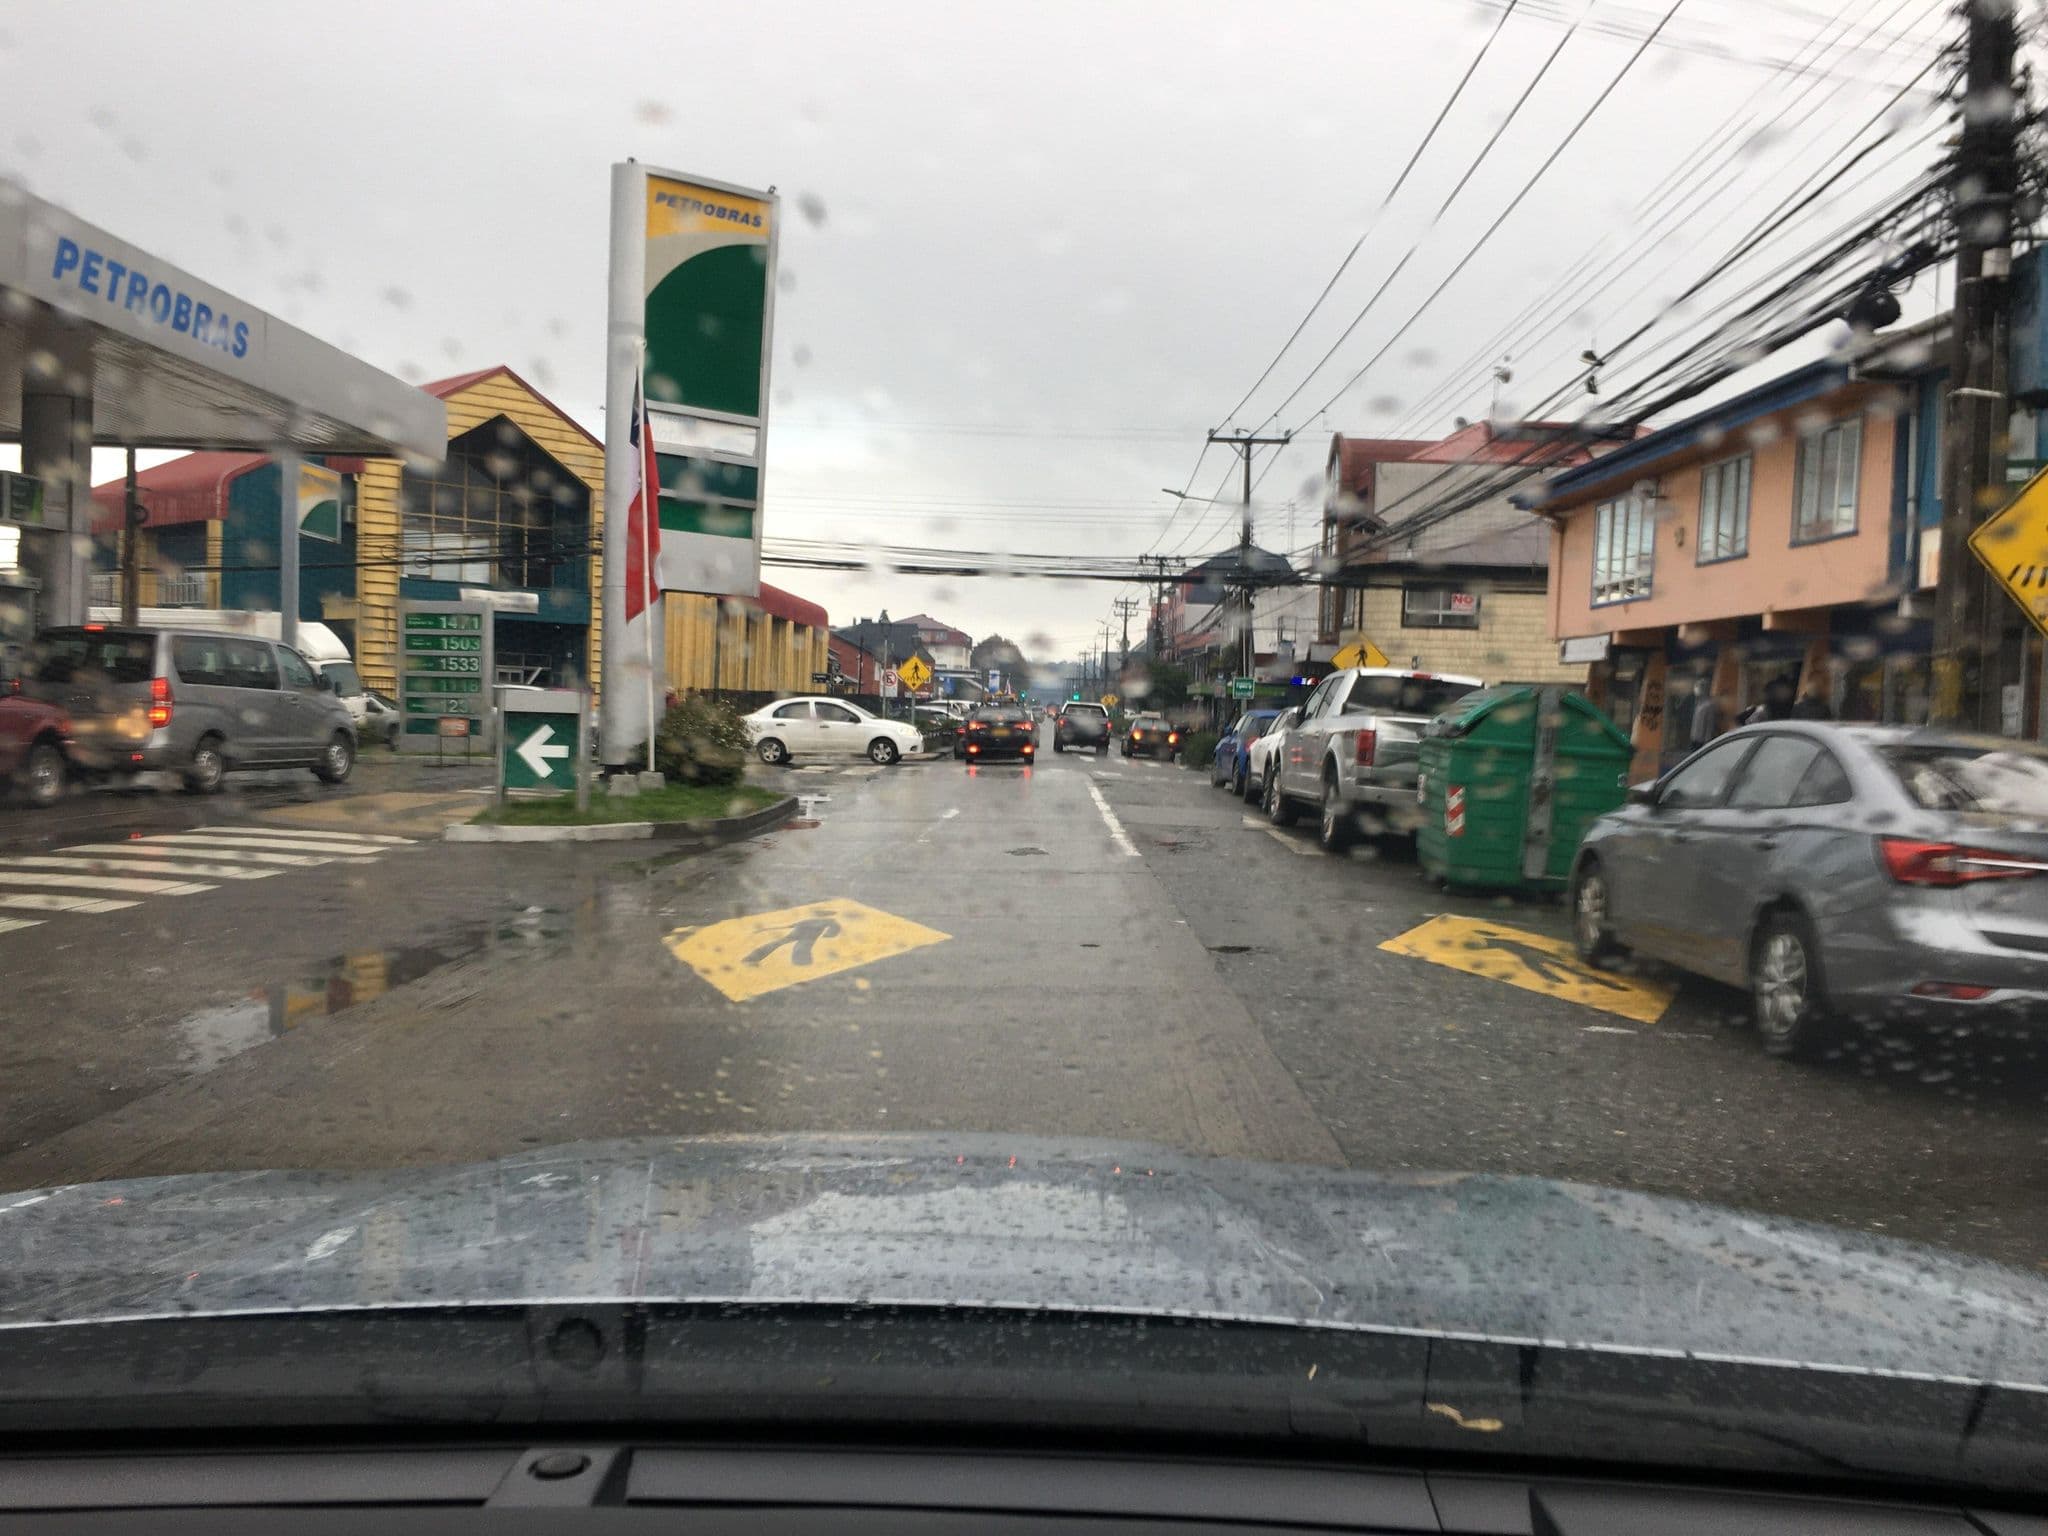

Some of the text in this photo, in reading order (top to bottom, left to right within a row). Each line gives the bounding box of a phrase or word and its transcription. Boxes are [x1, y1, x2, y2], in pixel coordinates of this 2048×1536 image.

[656, 192, 762, 227] PETROBRAS
[52, 236, 249, 358] PETROBRAS
[439, 656, 480, 672] 1533
